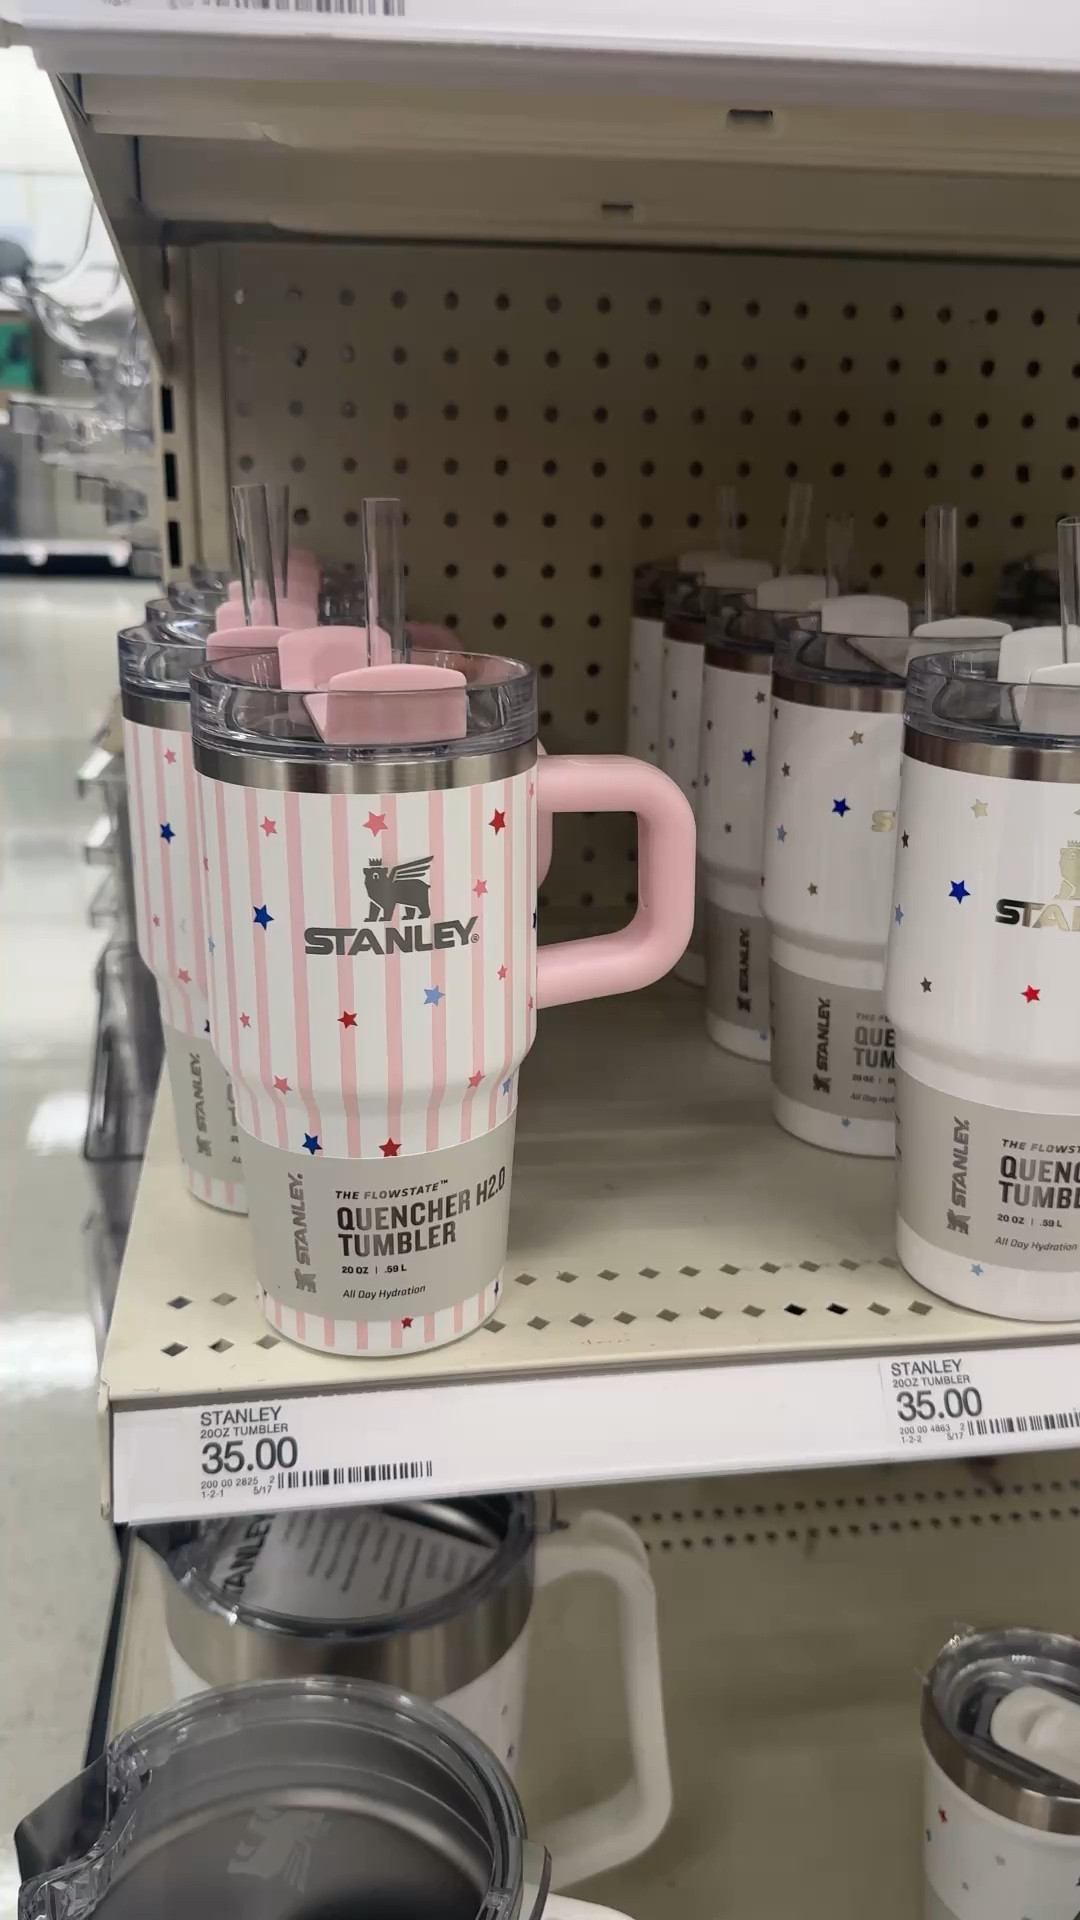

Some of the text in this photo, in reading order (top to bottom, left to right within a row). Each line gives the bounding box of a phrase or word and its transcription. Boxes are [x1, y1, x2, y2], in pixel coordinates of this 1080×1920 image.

[1002, 1138, 1027, 1151] THE
[335, 1190, 359, 1200] THE
[337, 1166, 506, 1231] QUENCHER H2.0
[997, 1213, 1062, 1228] 20 OZ .59 L
[338, 1220, 456, 1257] TUMBLER
[995, 1236, 1078, 1252] All Day Hydration
[341, 1264, 407, 1274] 20 OZ .59 L
[343, 1284, 426, 1301] All Day Hydration
[891, 1358, 963, 1377] STANLEY
[892, 1374, 970, 1388] 20OZ TUMBLER
[896, 1386, 982, 1421] 35.00
[200, 1406, 282, 1426] STANLEY
[200, 1423, 288, 1439] 20OZ TUMBLER
[947, 1432, 963, 1440] 5/17
[202, 1436, 298, 1475] 35.00
[200, 1480, 218, 1489] 200
[221, 1478, 233, 1487] 00
[269, 1475, 275, 1484] 2
[201, 1485, 272, 1498] 1-2-1 5/17
